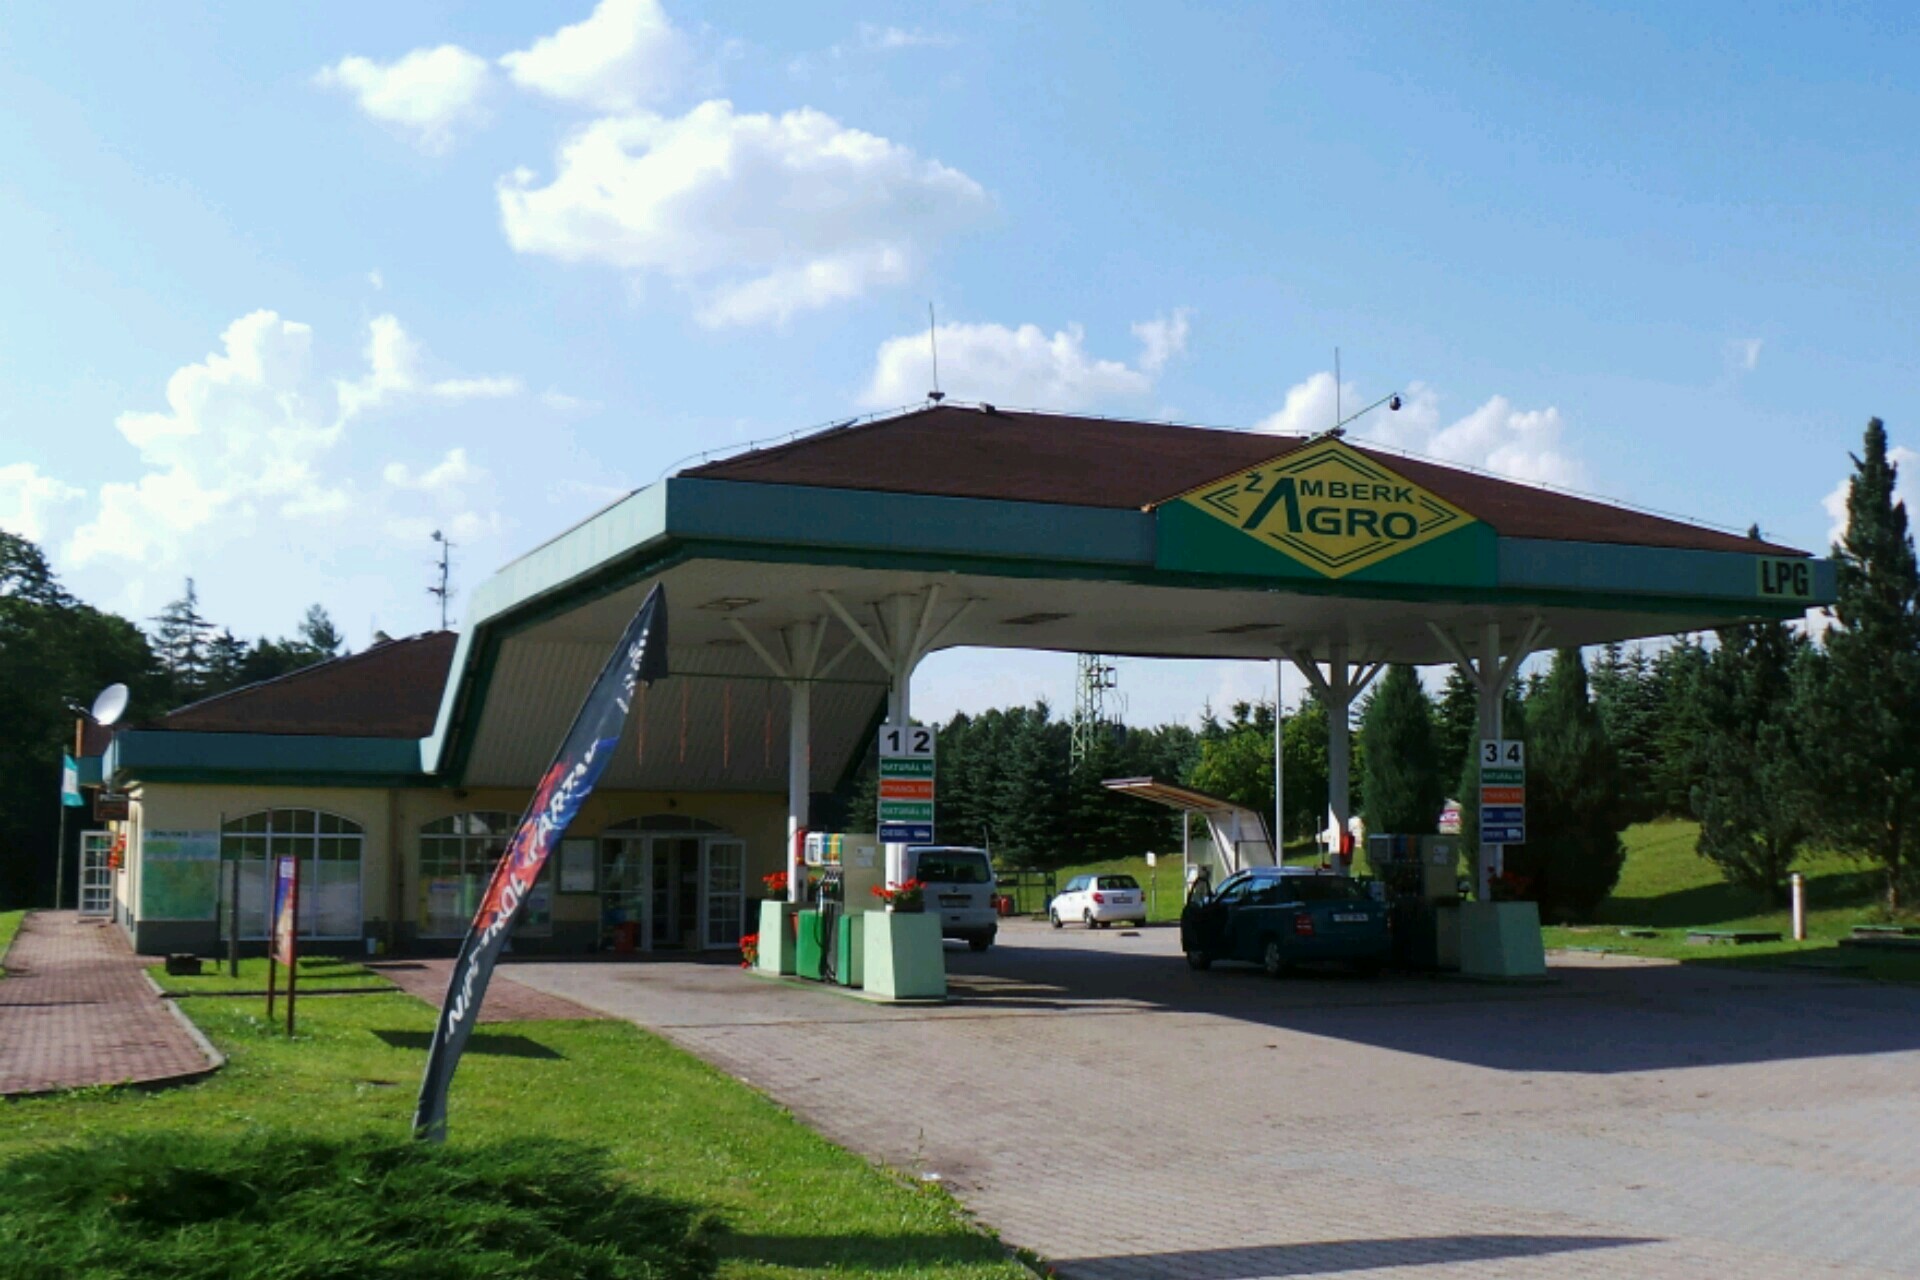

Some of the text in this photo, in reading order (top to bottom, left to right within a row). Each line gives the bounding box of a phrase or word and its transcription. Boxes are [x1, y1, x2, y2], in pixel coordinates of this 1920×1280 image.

[1762, 560, 1809, 596] LPG
[887, 730, 930, 753] 1 2
[1485, 743, 1520, 762] 3 4
